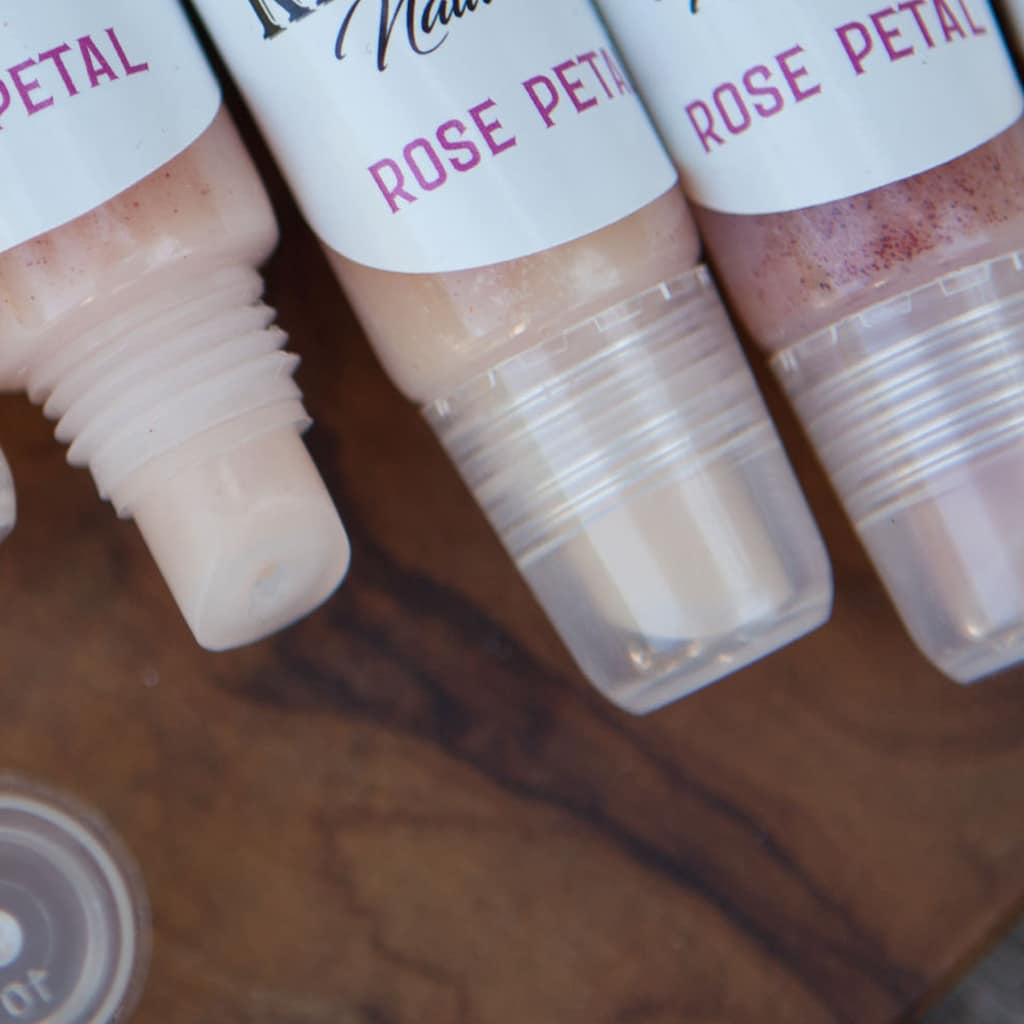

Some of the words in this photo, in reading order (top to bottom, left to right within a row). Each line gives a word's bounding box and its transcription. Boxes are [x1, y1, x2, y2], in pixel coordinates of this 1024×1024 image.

[367, 97, 518, 215] ROSE
[521, 47, 634, 129] PETA
[684, 44, 823, 154] ROSE
